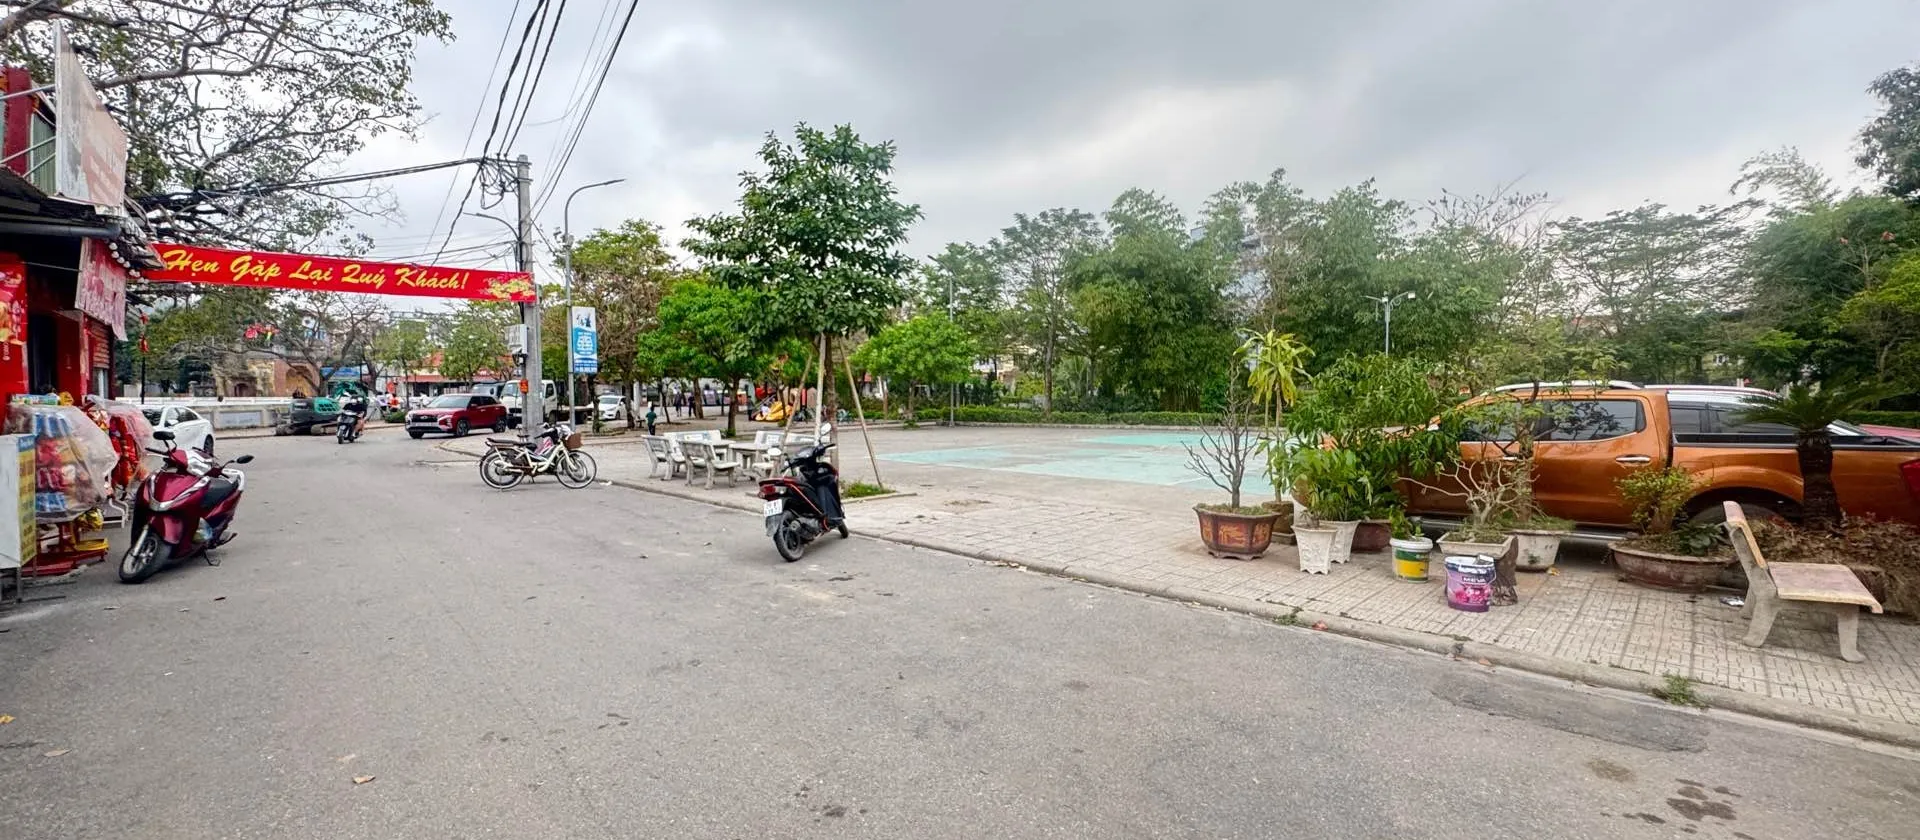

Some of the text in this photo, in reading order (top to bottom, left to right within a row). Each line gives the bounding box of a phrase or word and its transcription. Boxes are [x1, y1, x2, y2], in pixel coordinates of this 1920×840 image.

[163, 249, 469, 290] Hẹn Gặp Lại Quý Khách!
